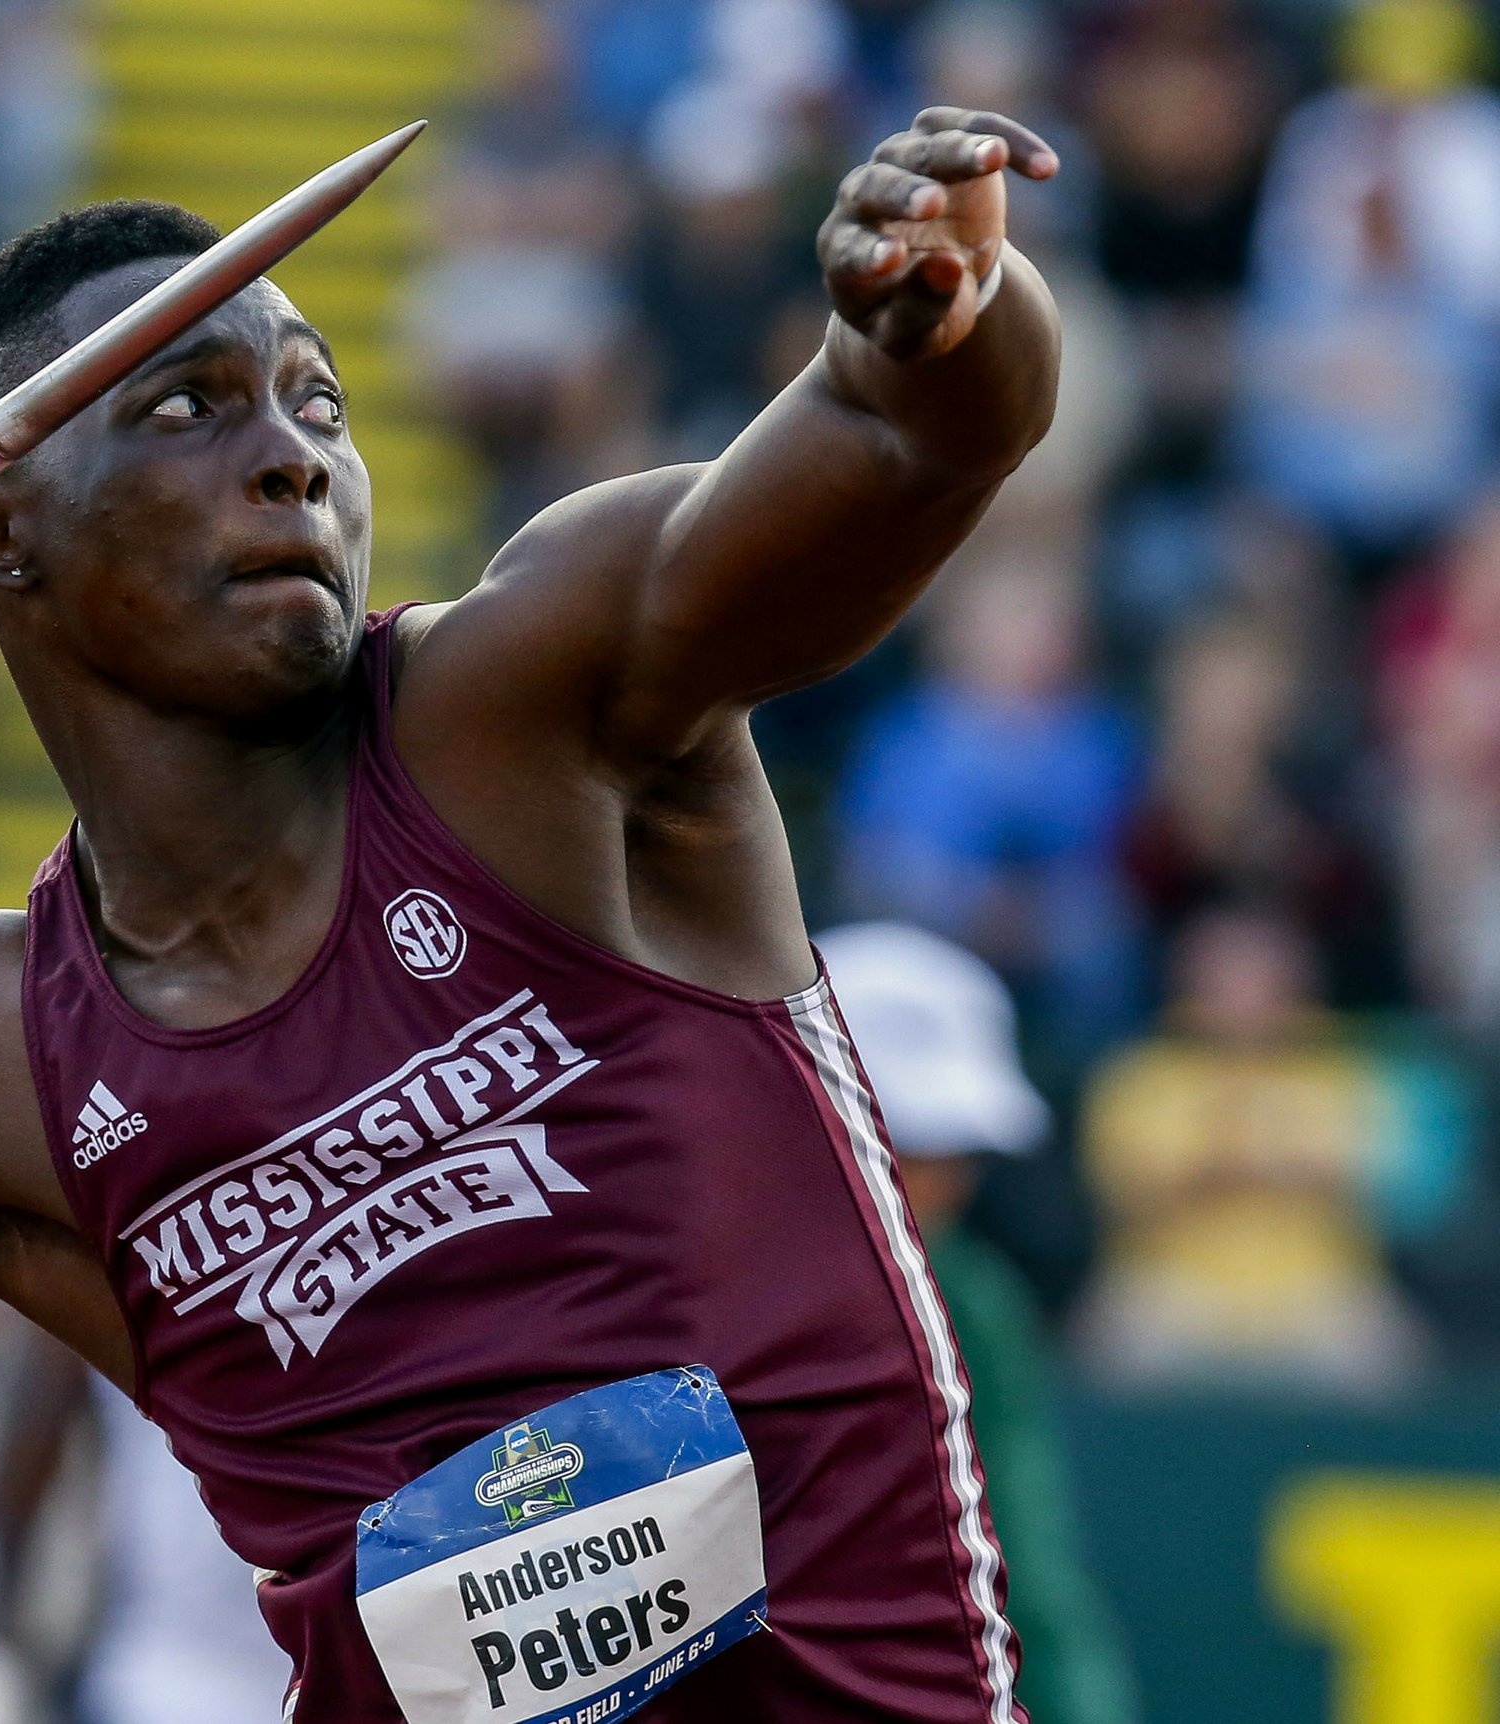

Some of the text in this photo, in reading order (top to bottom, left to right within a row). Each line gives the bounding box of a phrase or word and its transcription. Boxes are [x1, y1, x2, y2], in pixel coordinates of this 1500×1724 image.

[391, 899, 458, 968] SEC
[73, 1110, 147, 1170] adidas
[132, 1002, 585, 1298] MISSISSIPPI
[293, 1160, 515, 1318] STATE
[487, 1456, 573, 1497] CHAMPIONSHIPS
[457, 1515, 668, 1622] Anderson
[470, 1578, 691, 1711] Peters
[576, 1691, 621, 1724] FIELD
[643, 1650, 686, 1691] JUNE
[688, 1631, 716, 1662] 6-9
